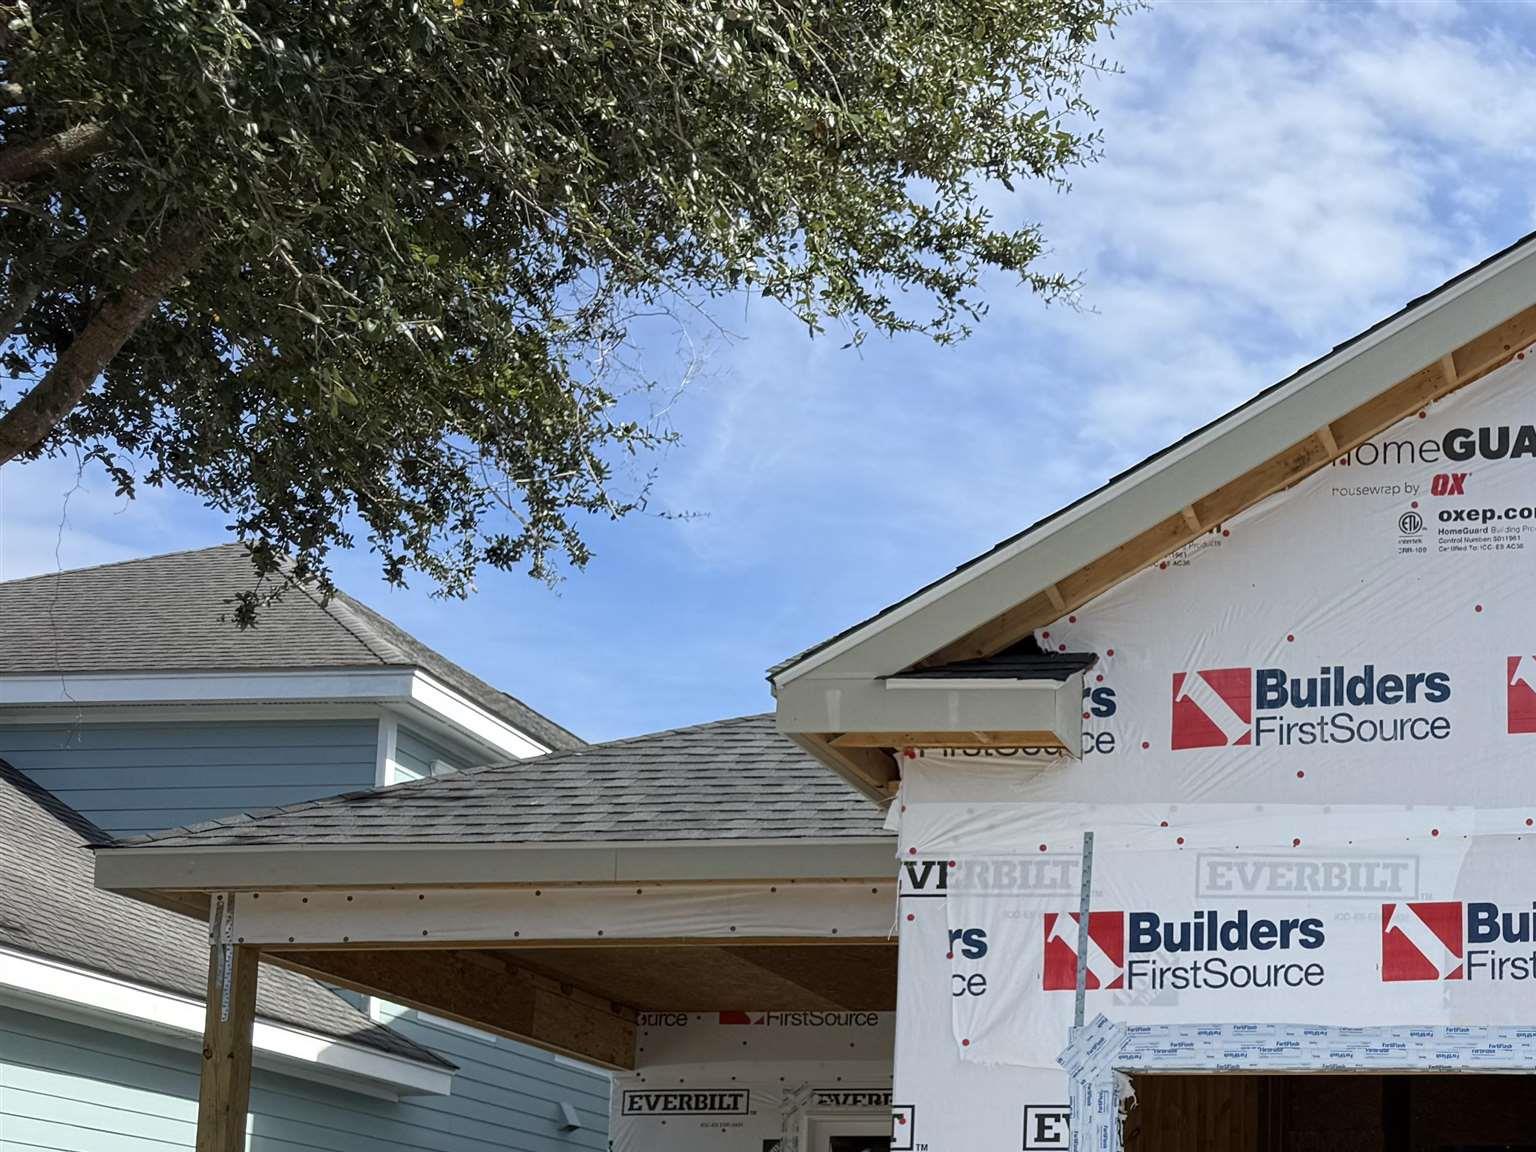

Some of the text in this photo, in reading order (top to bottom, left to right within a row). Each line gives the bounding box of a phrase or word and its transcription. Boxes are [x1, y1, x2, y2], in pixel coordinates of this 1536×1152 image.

[1404, 482, 1420, 497] by
[1430, 473, 1466, 496] OX
[1438, 527, 1488, 535] HomeGuard
[1256, 664, 1451, 709] Builders
[1254, 712, 1451, 746] FirstSource
[1206, 861, 1408, 892] EVERBILT
[1128, 909, 1325, 954] Builders
[1127, 957, 1325, 990] FirstSource
[627, 1093, 744, 1112] EVERBILT
